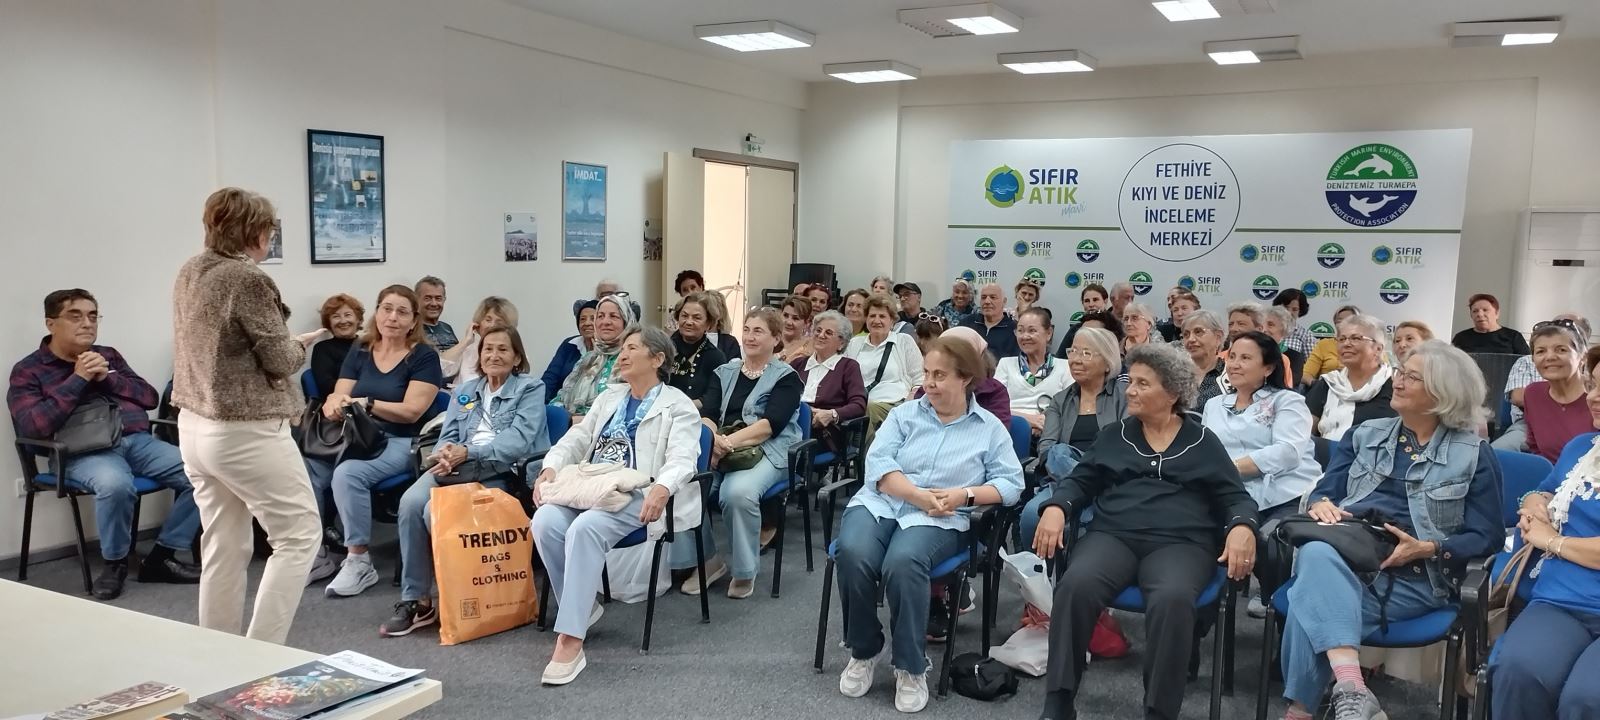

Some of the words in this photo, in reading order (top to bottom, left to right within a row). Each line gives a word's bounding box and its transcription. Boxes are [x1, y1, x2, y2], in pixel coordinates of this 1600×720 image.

[1330, 155, 1350, 179] TURKISH
[1350, 146, 1377, 157] MARINE
[1156, 160, 1212, 177] FETHİYE
[1029, 168, 1079, 185] SIFIR
[1326, 181, 1375, 189] DENİZTEMİZ
[1378, 181, 1416, 189] TURMEPA
[1029, 187, 1078, 205] ATIK
[1132, 187, 1157, 201] KIYI
[1162, 186, 1180, 200] VE
[1184, 182, 1226, 200] DENİZ
[1145, 206, 1216, 223] İNCELEME
[1331, 203, 1366, 226] PROTECTION
[1367, 203, 1409, 226] ASSOCIATION
[1150, 228, 1212, 246] MERKEZİ
[1031, 241, 1052, 249] SIFIR
[1261, 245, 1286, 253] SIFIR
[1031, 249, 1051, 257] ATIK
[1395, 247, 1422, 255] SIFIR
[1261, 253, 1284, 262] ATIK
[1395, 255, 1421, 264] ATIK
[977, 270, 998, 278] SIFIR
[1083, 272, 1104, 280] SIFIR
[1198, 276, 1221, 284] SIFIR
[1198, 284, 1220, 293] ATIK
[1323, 281, 1348, 289] SIFIR
[1323, 289, 1347, 298] ATIK
[459, 527, 529, 548] TRENDY
[481, 552, 511, 563] BAGS
[494, 564, 501, 572] &
[472, 571, 527, 586] CLOTHING
